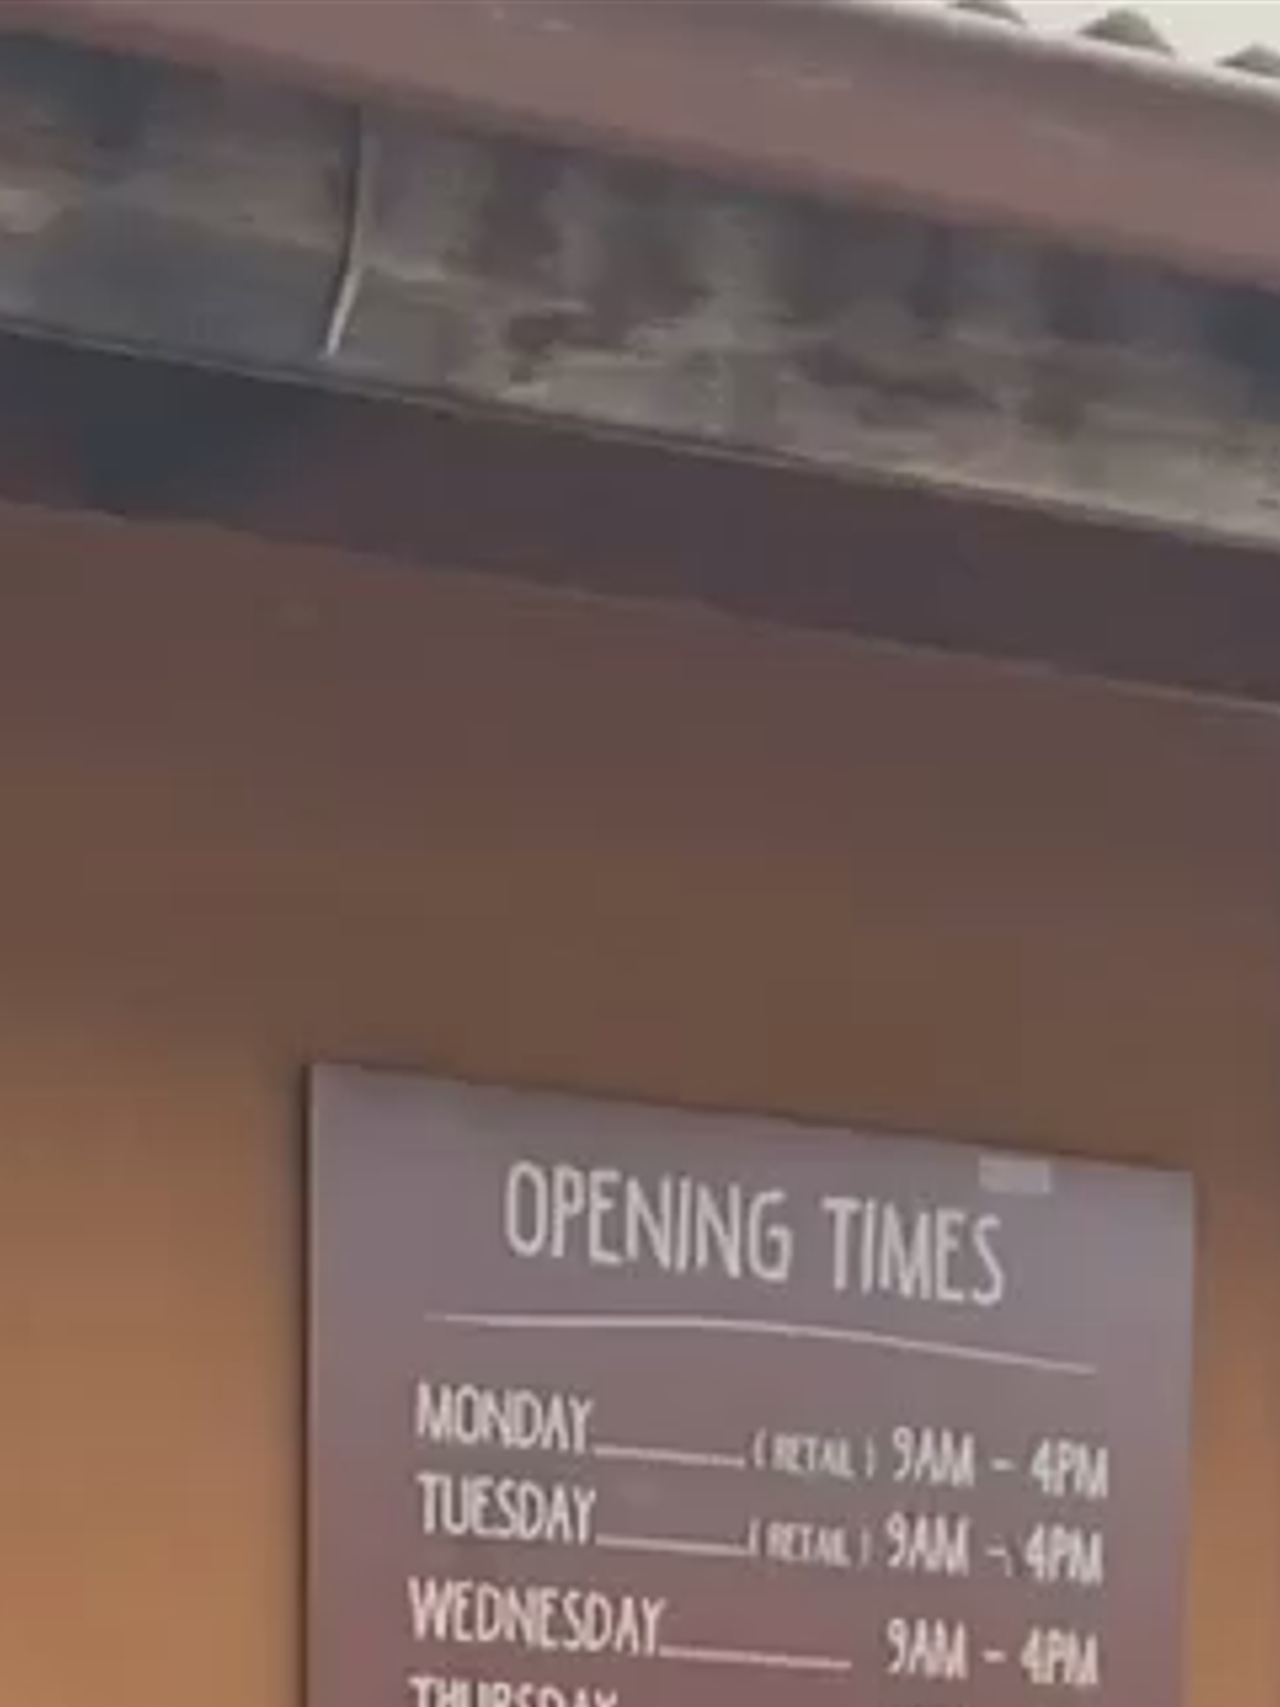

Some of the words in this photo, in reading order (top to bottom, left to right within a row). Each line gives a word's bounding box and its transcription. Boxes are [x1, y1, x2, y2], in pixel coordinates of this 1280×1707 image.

[505, 1161, 793, 1283] OPENING
[822, 1196, 1005, 1307] TIMES
[416, 1381, 593, 1454] MONDAY
[892, 1426, 975, 1487] 9AM
[1031, 1439, 1108, 1499] 4PM
[416, 1471, 597, 1545] TUESDAY
[886, 1512, 969, 1574] 9AM
[1025, 1524, 1103, 1584] 4PM
[408, 1577, 669, 1657] WEDNESDAY
[887, 1617, 967, 1679] 9AM
[1020, 1628, 1099, 1687] 4PM
